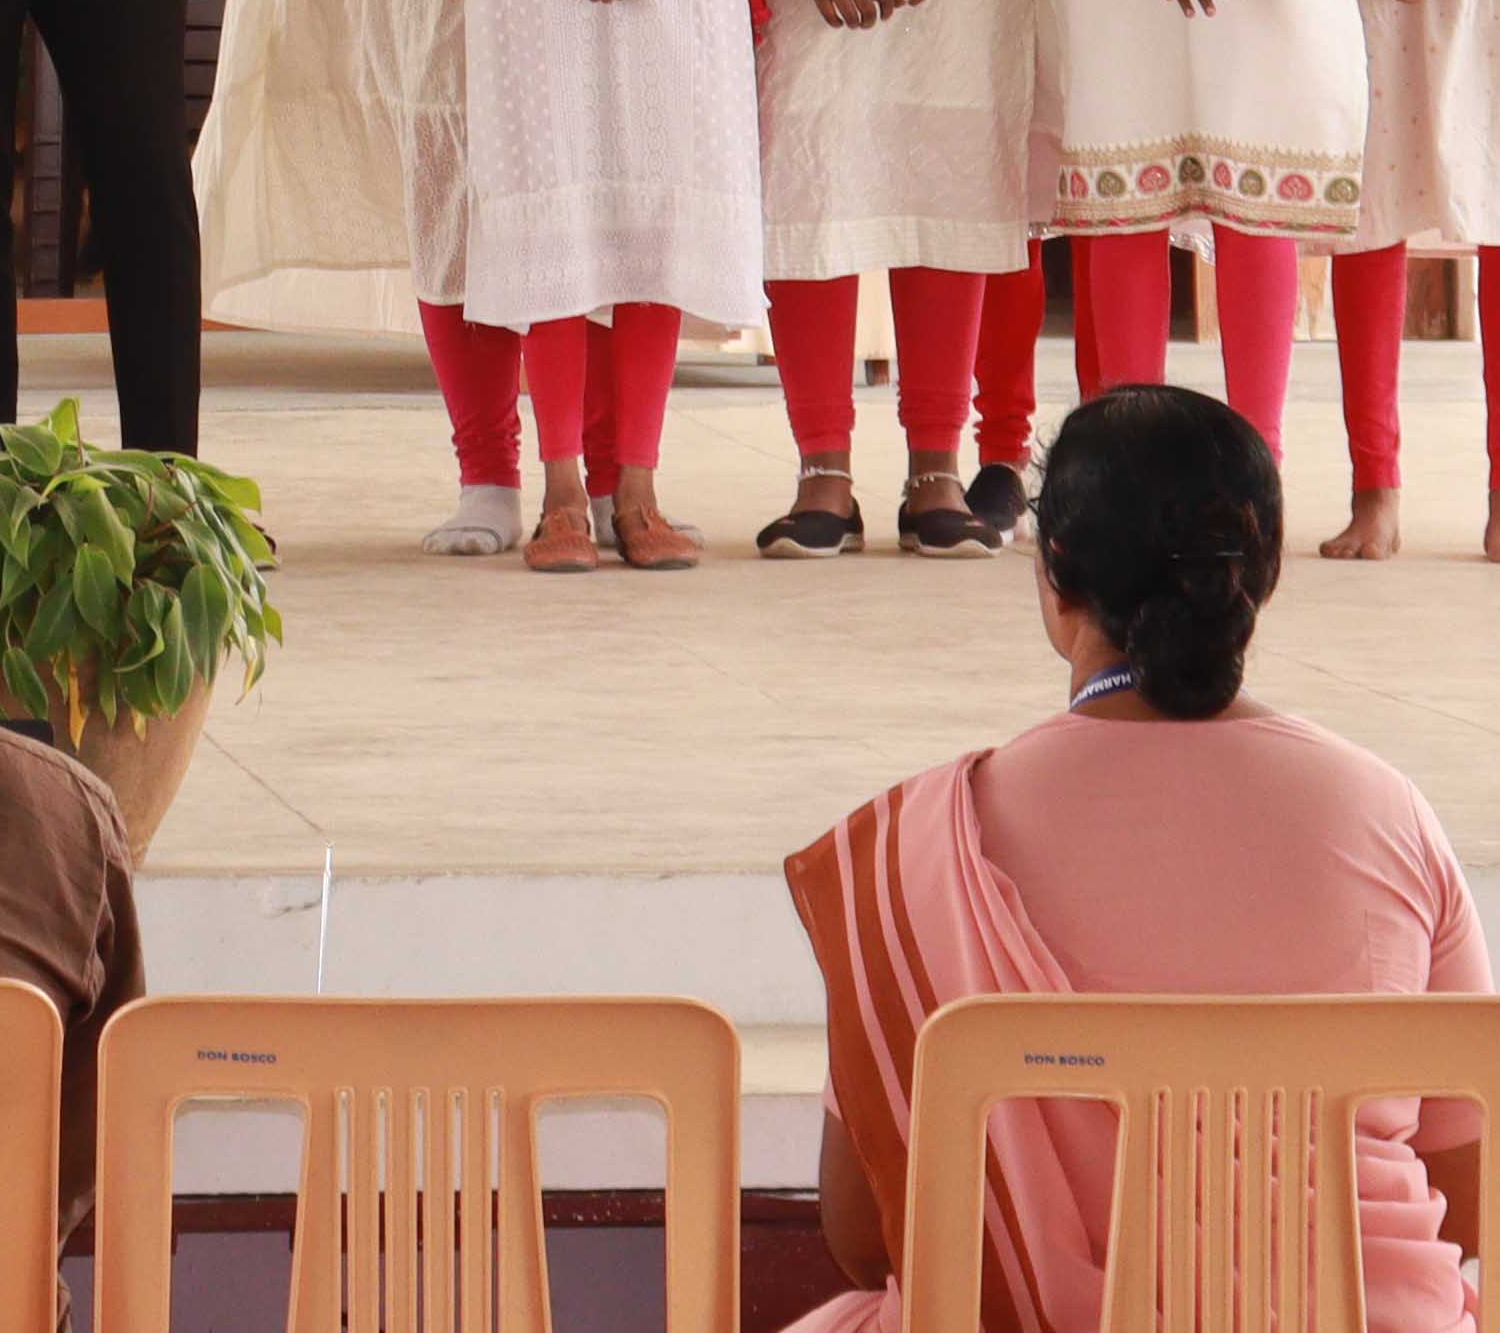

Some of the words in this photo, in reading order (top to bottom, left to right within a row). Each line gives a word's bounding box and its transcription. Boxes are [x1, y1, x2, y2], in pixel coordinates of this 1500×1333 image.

[197, 1050, 228, 1061] DON
[231, 1052, 277, 1063] BOSCO
[1024, 1054, 1055, 1064] DON
[1059, 1055, 1105, 1066] BOSCO
